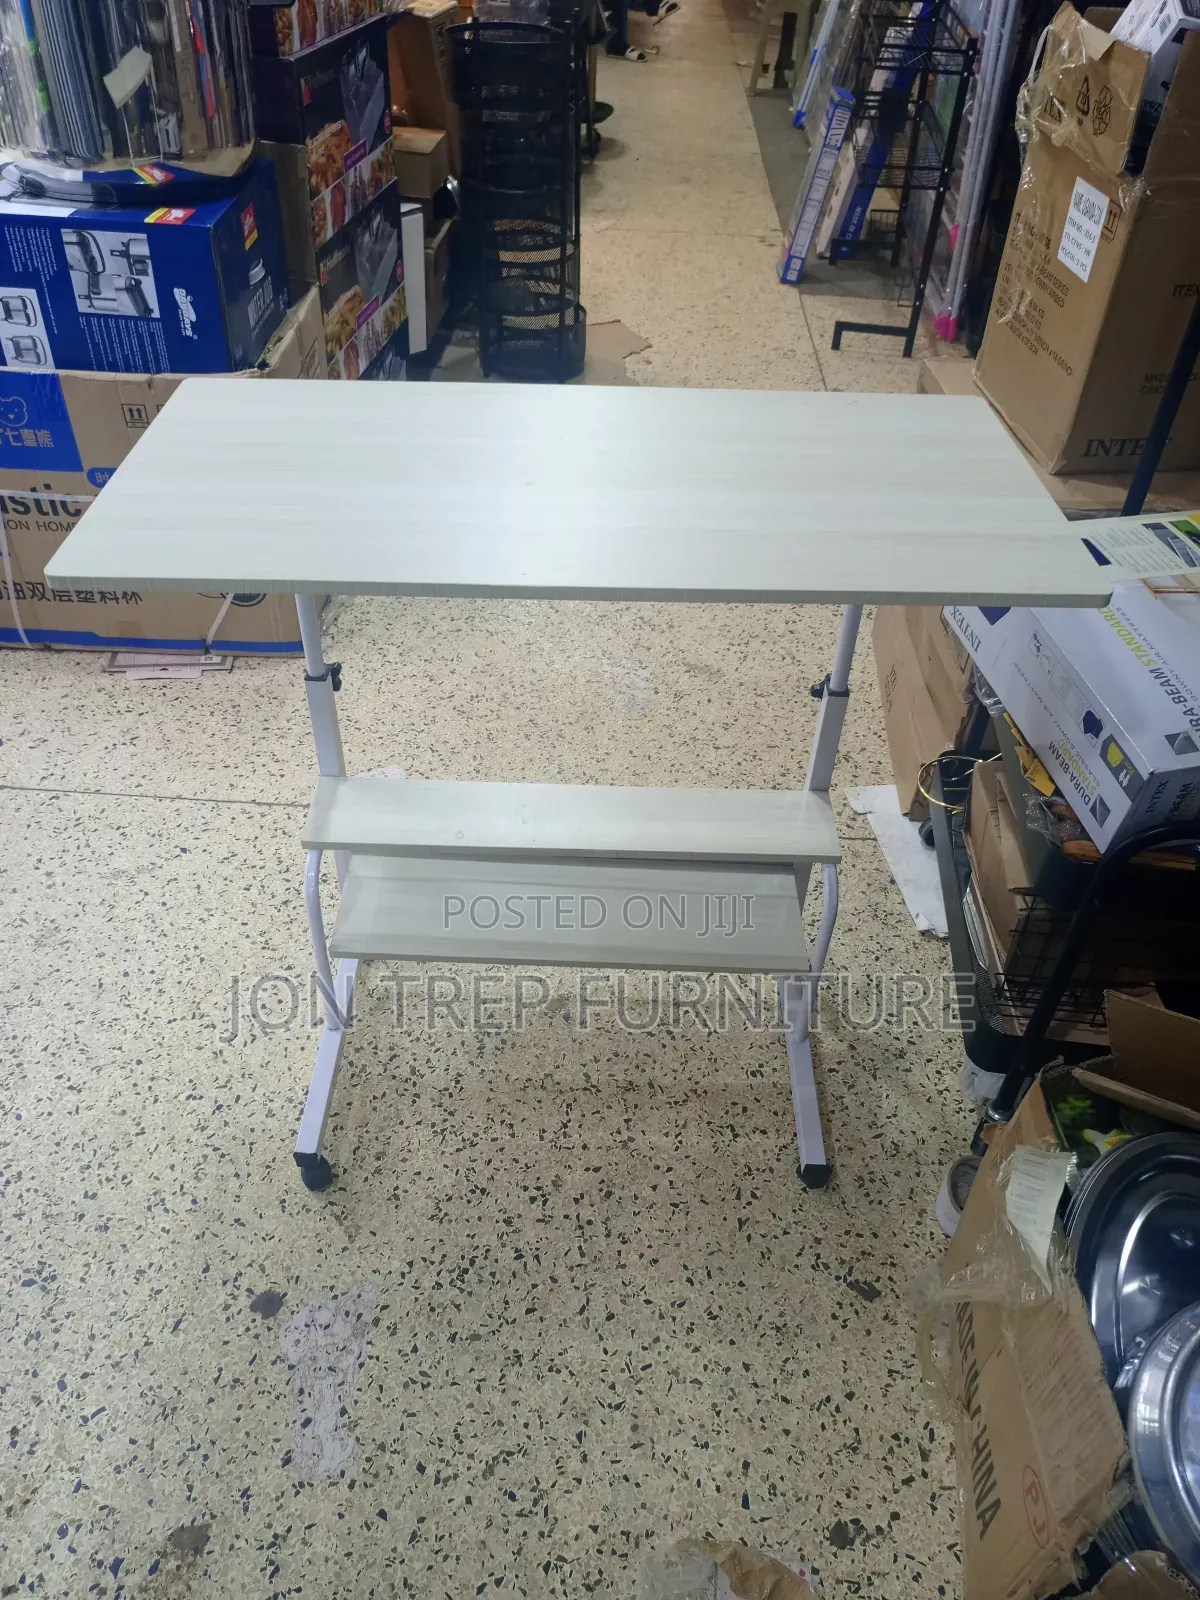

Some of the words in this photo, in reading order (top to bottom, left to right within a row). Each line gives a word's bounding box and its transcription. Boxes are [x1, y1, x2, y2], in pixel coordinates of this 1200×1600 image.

[1081, 437, 1151, 458] INTE
[0, 484, 82, 517] stic
[0, 580, 143, 605] 油双层塑料杯
[950, 606, 982, 654] INTEX
[1048, 740, 1092, 806] DURA-BEAM
[954, 1301, 976, 1375] ADE
